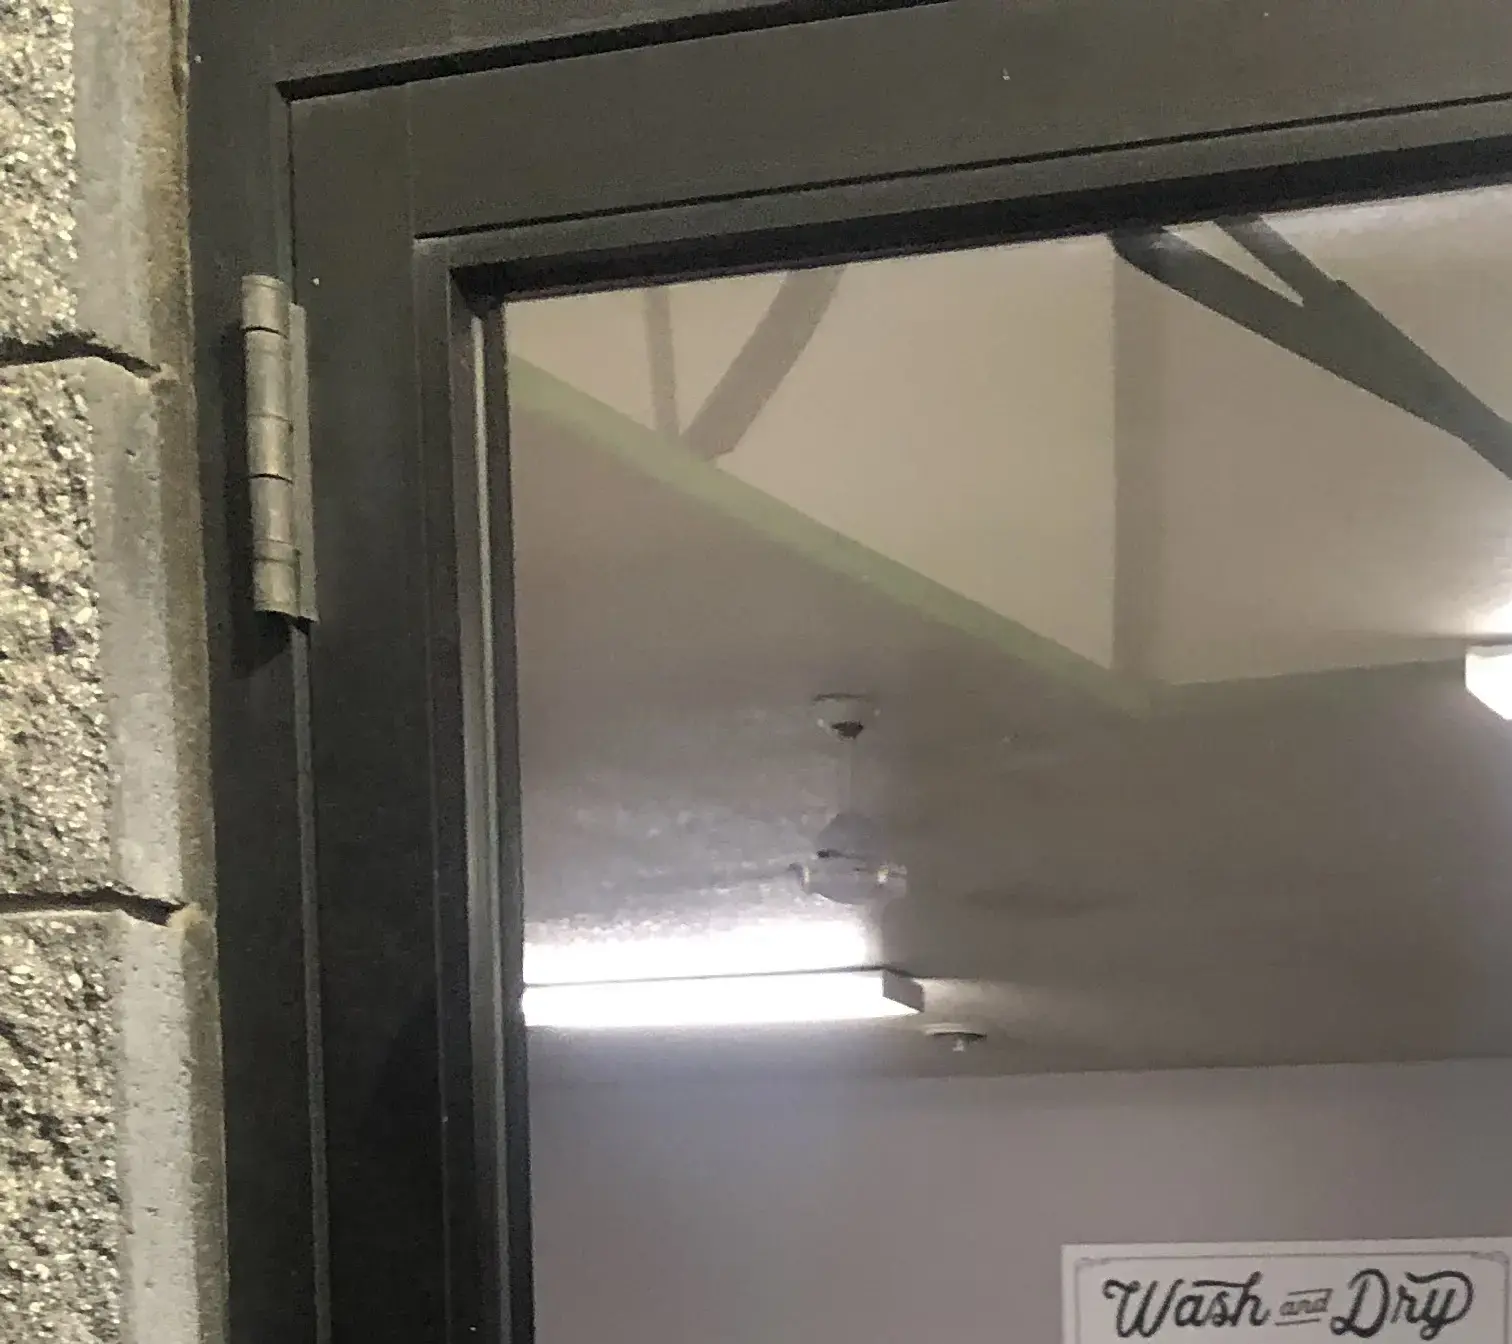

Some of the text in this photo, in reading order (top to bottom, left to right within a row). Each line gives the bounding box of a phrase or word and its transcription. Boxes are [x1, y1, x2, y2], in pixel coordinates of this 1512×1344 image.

[1102, 1268, 1474, 1341] Wash and Dry
